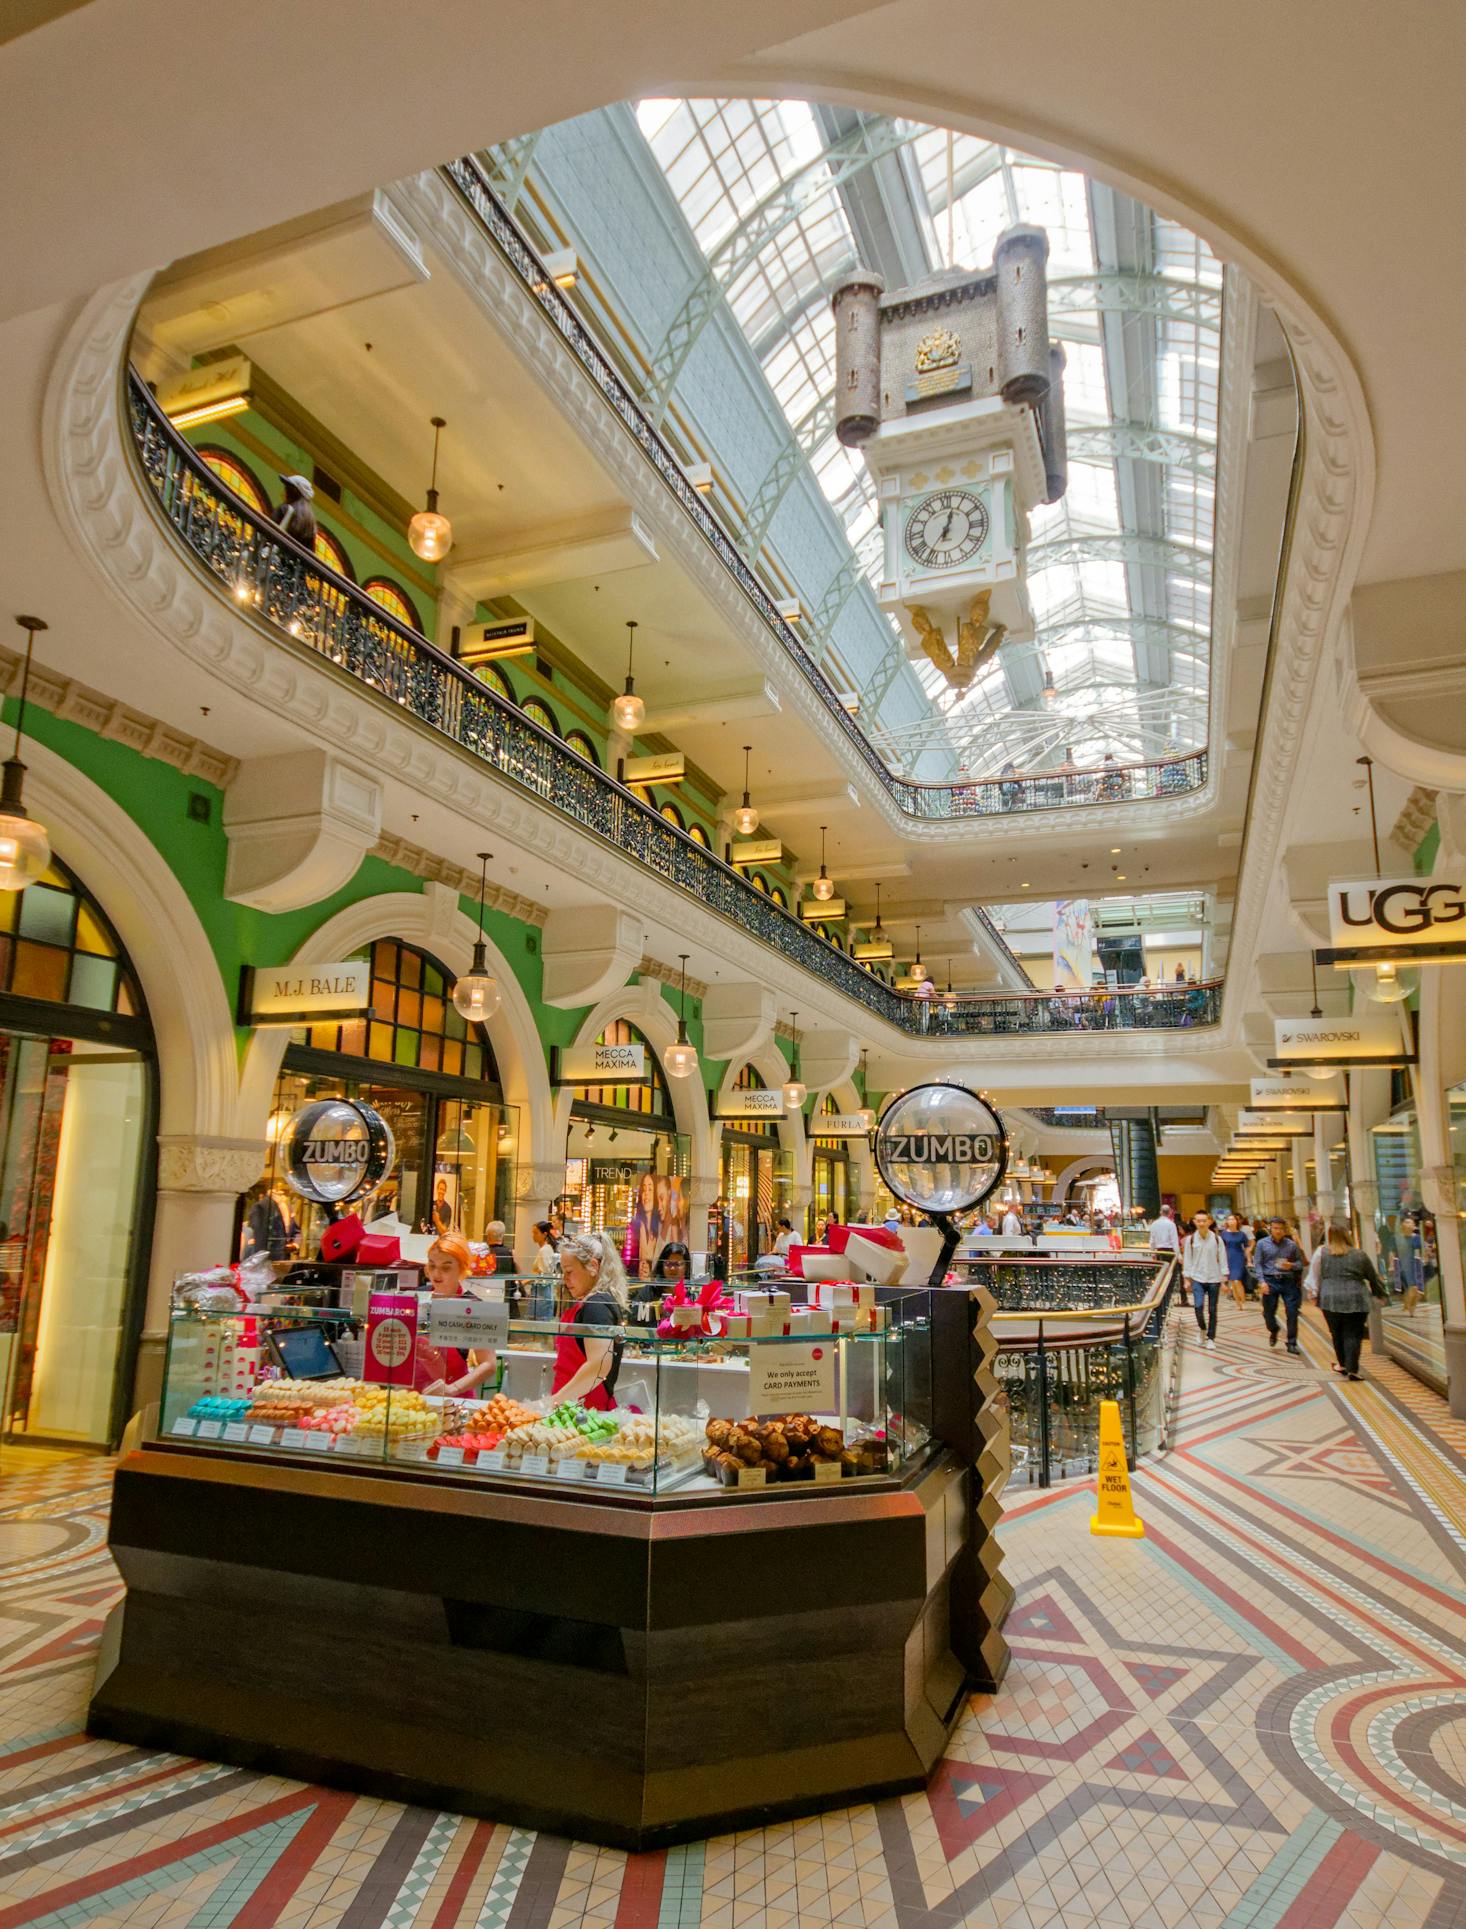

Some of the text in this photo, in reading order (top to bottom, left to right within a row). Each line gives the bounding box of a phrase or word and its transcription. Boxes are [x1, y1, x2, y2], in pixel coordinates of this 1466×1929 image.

[1338, 884, 1466, 934] UGG
[274, 976, 356, 998] M.J. BALE
[1296, 1031, 1360, 1042] SWAROVSKI
[595, 1049, 633, 1060] MECCA
[595, 1060, 637, 1070] MAXIMA
[744, 1094, 775, 1102] MECCA
[826, 1120, 862, 1129] FURLA
[302, 1140, 369, 1163] ZUMBO
[890, 1135, 992, 1162] ZUMBO
[594, 1167, 632, 1179] TREND
[767, 1370, 817, 1379] We only accept
[763, 1380, 821, 1390] CARD PAYMENTS
[1105, 1475, 1122, 1484] WET
[1102, 1483, 1128, 1493] FLOOR
